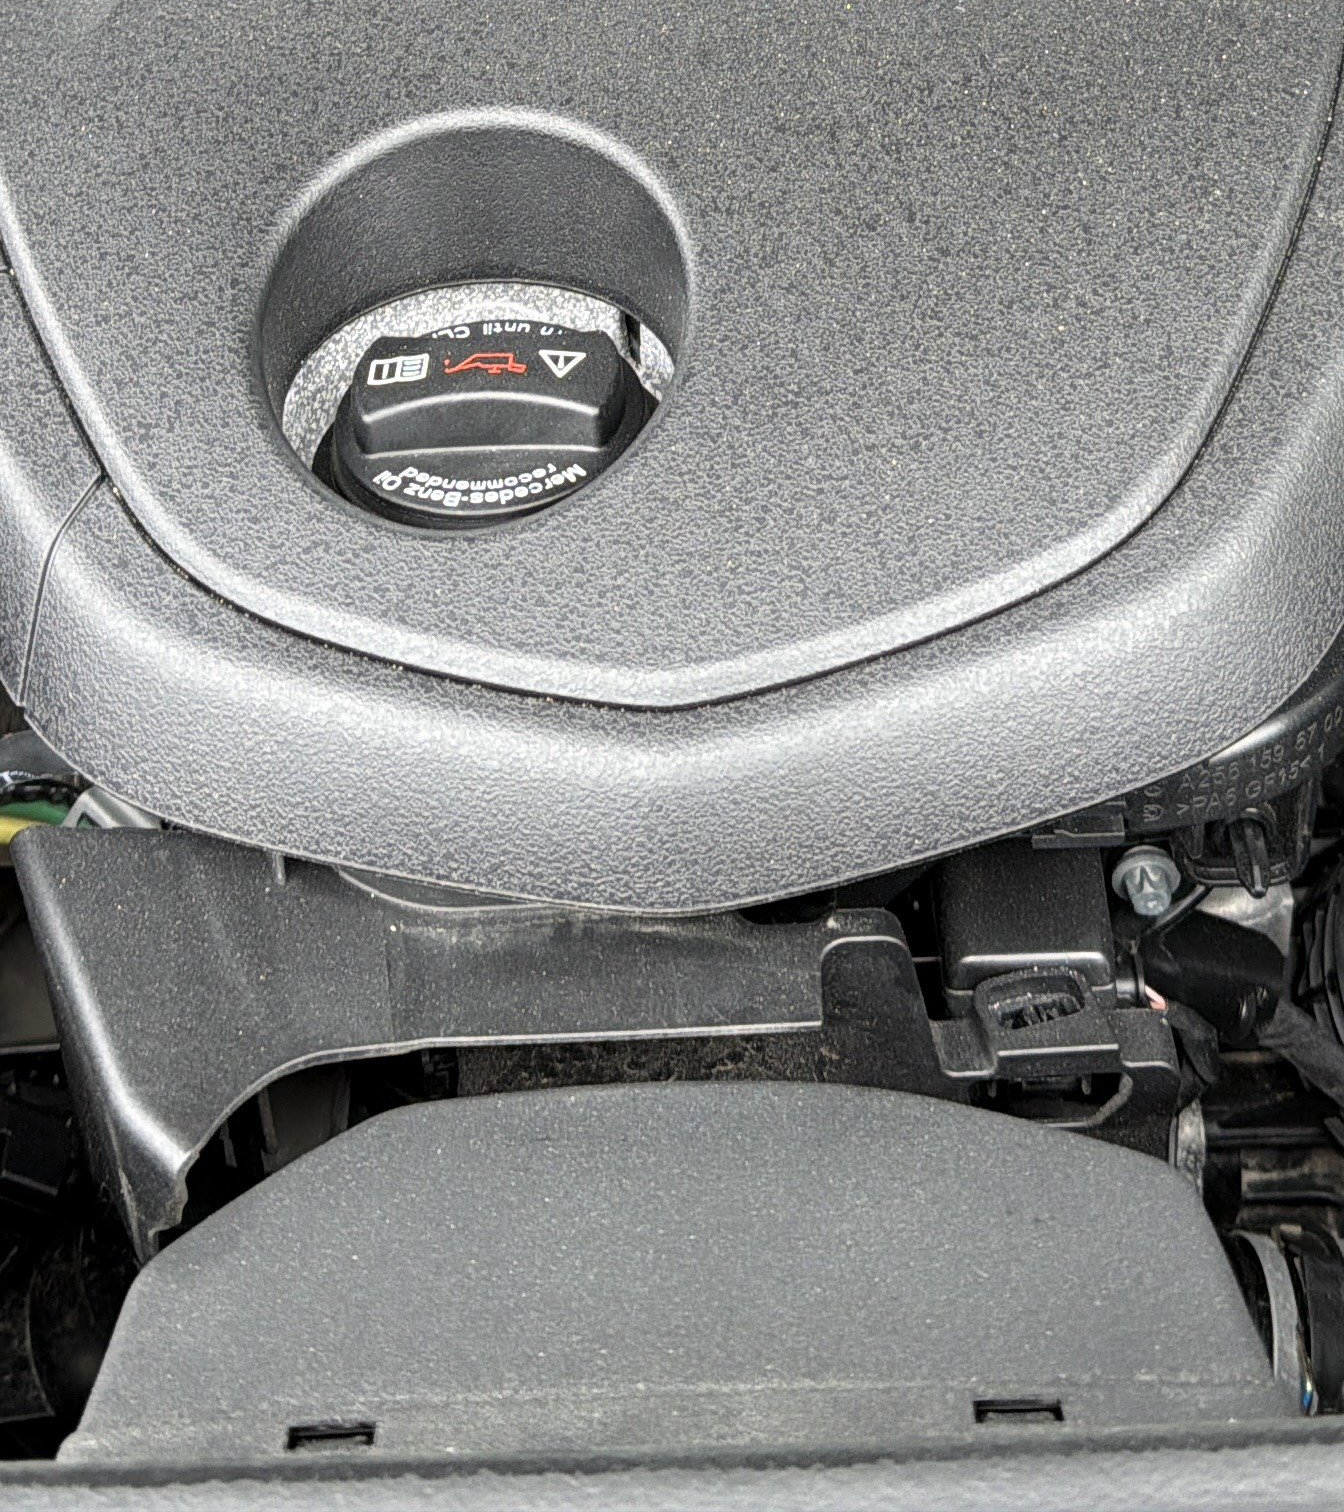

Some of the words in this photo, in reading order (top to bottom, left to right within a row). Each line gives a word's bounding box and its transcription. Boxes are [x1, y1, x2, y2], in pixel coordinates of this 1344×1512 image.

[482, 322, 531, 336] until
[372, 469, 402, 491] Oil
[398, 462, 557, 491] recommended
[403, 463, 587, 507] Mercedes-Benz
